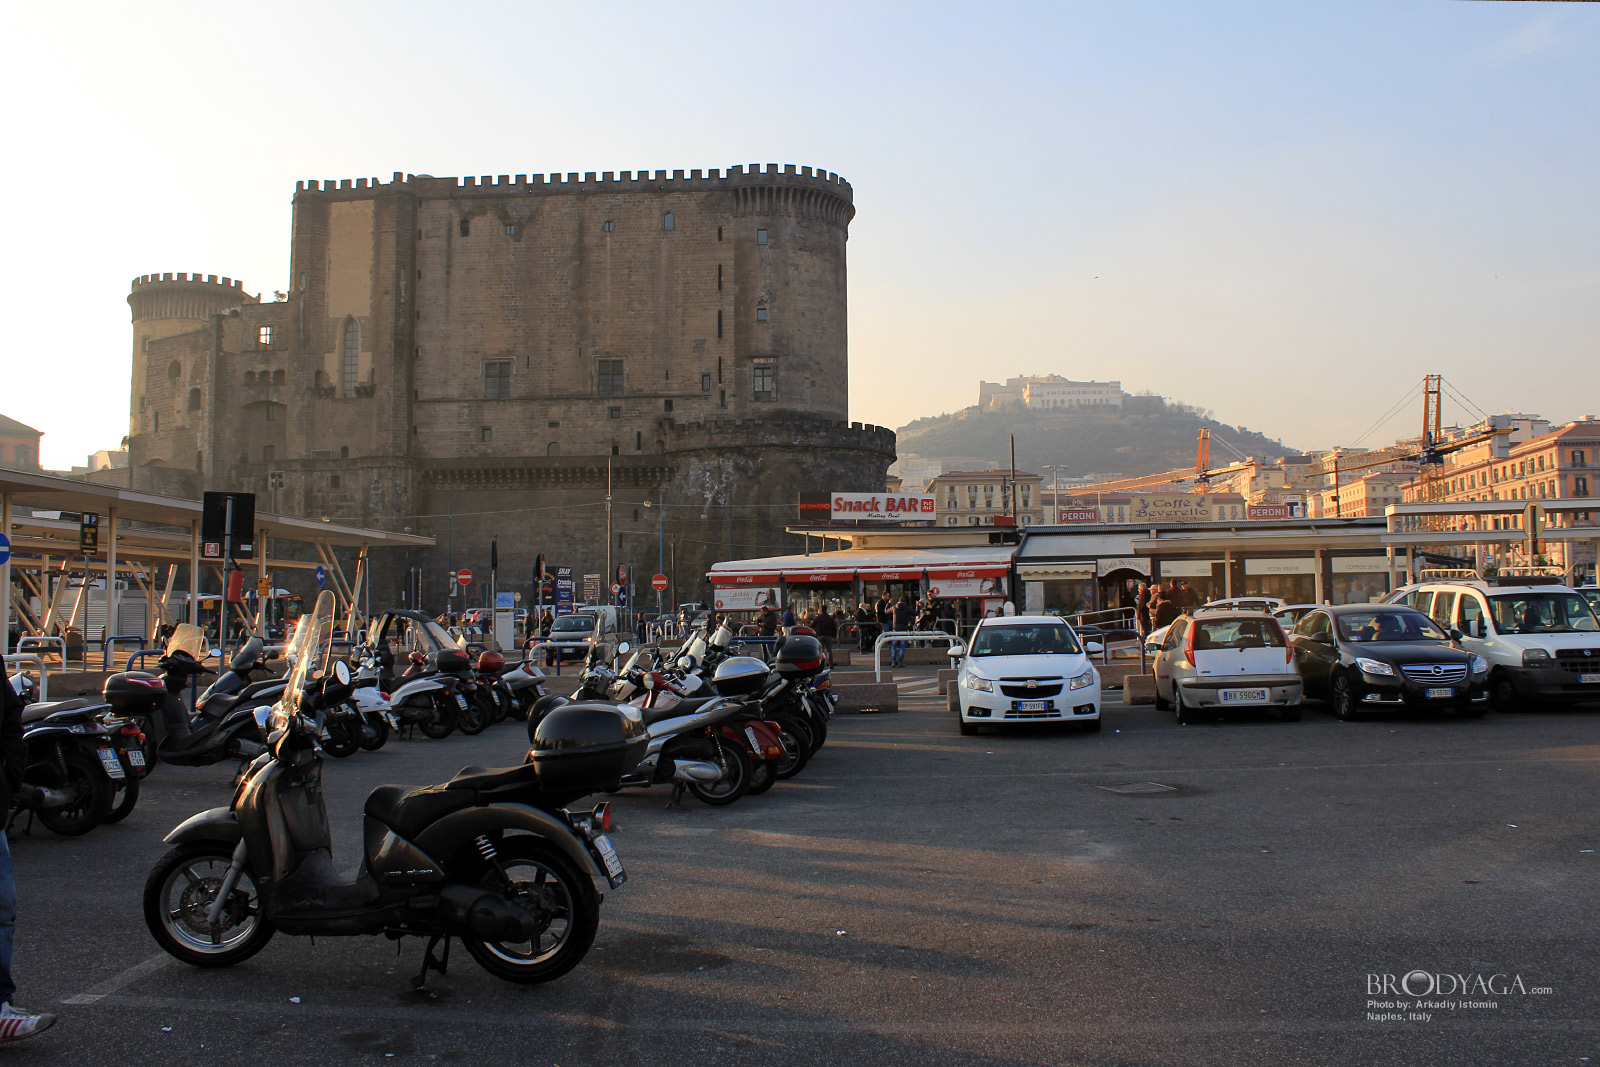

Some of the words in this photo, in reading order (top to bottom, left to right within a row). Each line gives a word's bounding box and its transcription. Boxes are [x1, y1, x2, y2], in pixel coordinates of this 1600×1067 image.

[833, 497, 880, 512] Snack
[885, 497, 919, 512] BAR
[1061, 512, 1095, 520] PERONI
[1135, 508, 1209, 518] Beverello
[1250, 508, 1285, 517] PERONI
